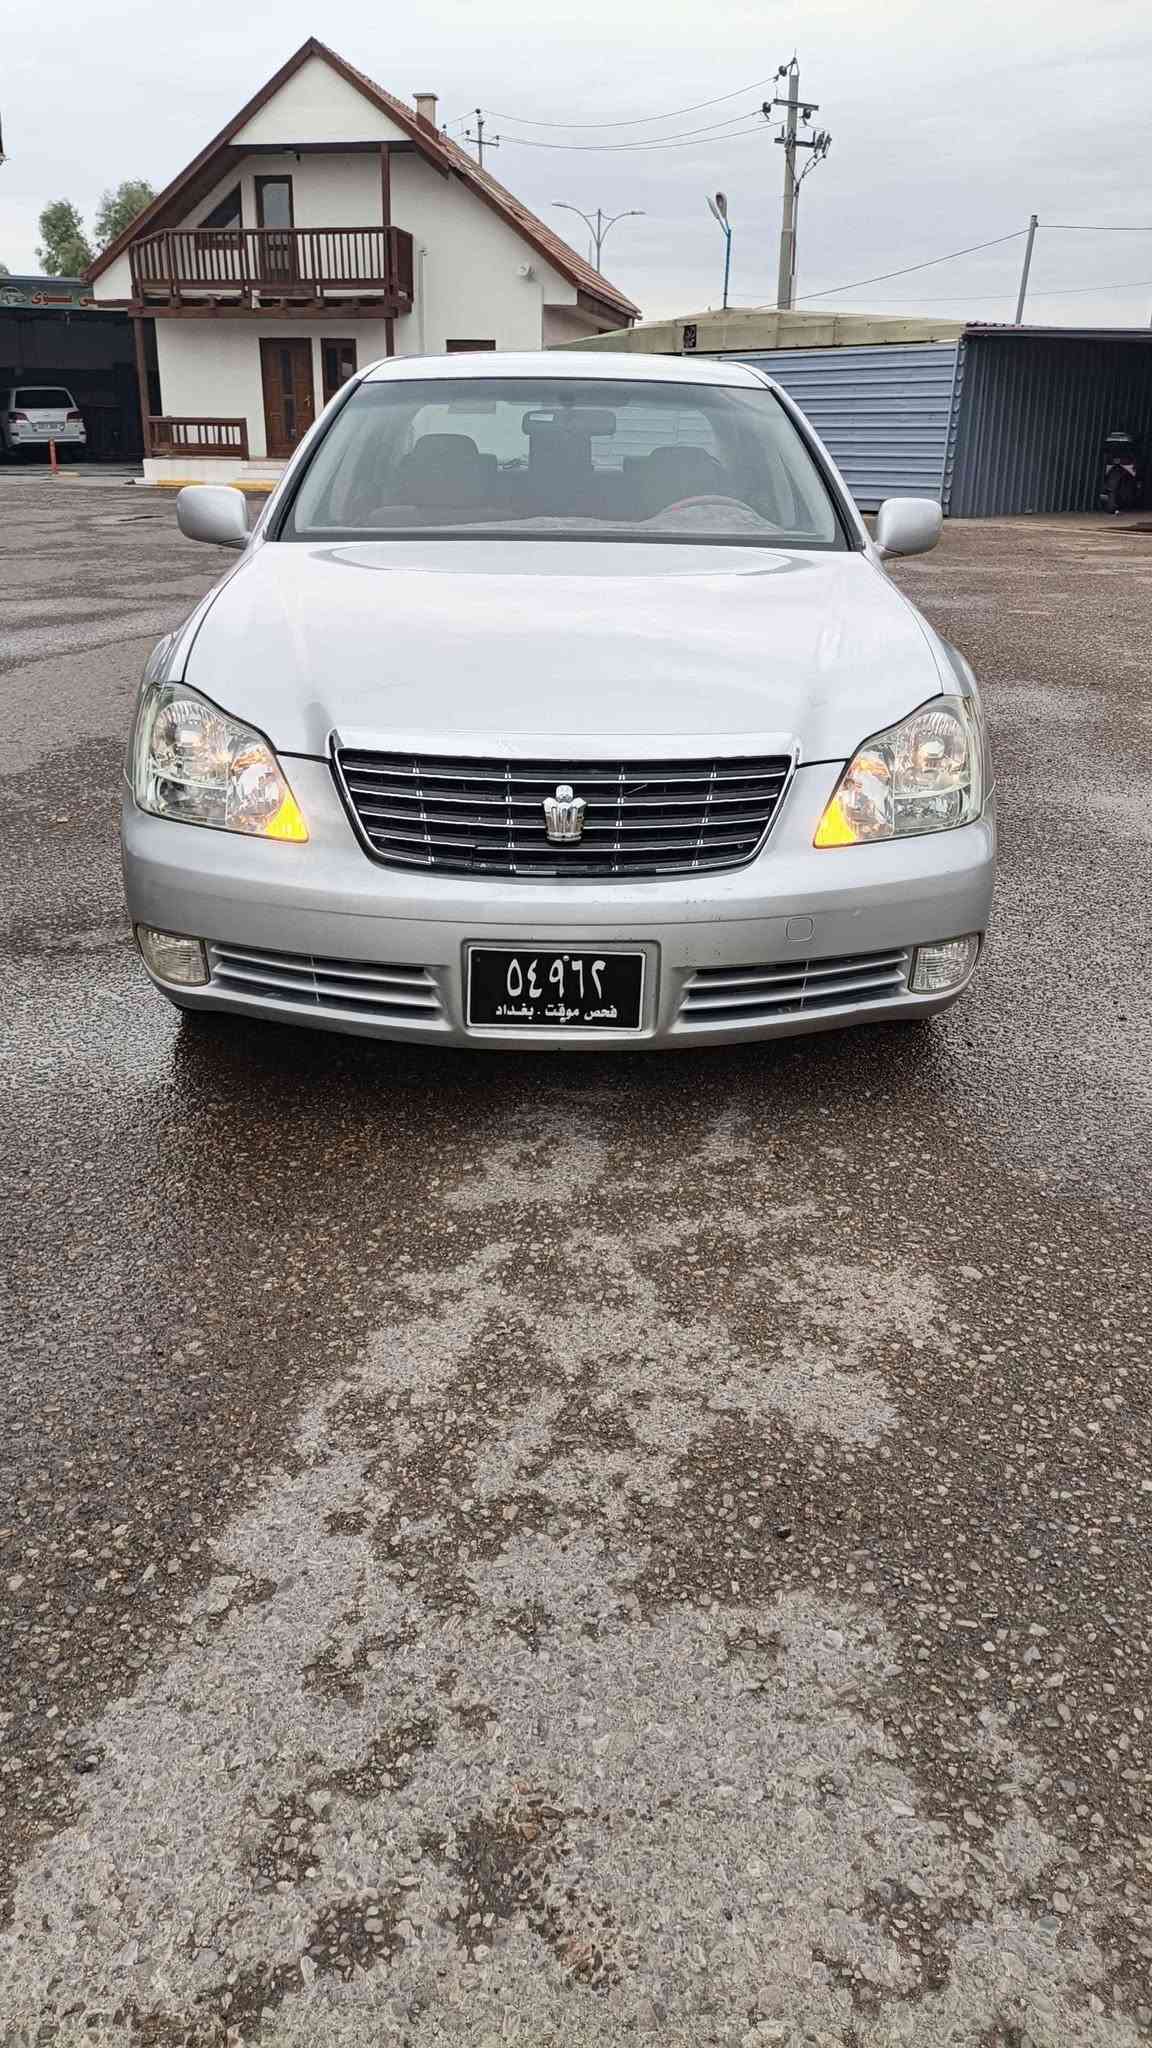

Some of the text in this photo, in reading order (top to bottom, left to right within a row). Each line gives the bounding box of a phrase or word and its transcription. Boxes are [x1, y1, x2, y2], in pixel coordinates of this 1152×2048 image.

[506, 958, 607, 999] ٥٤٩٦٢
[495, 1002, 534, 1020] بغداد
[544, 1003, 580, 1023] موقت
[583, 1004, 618, 1021] فحص
